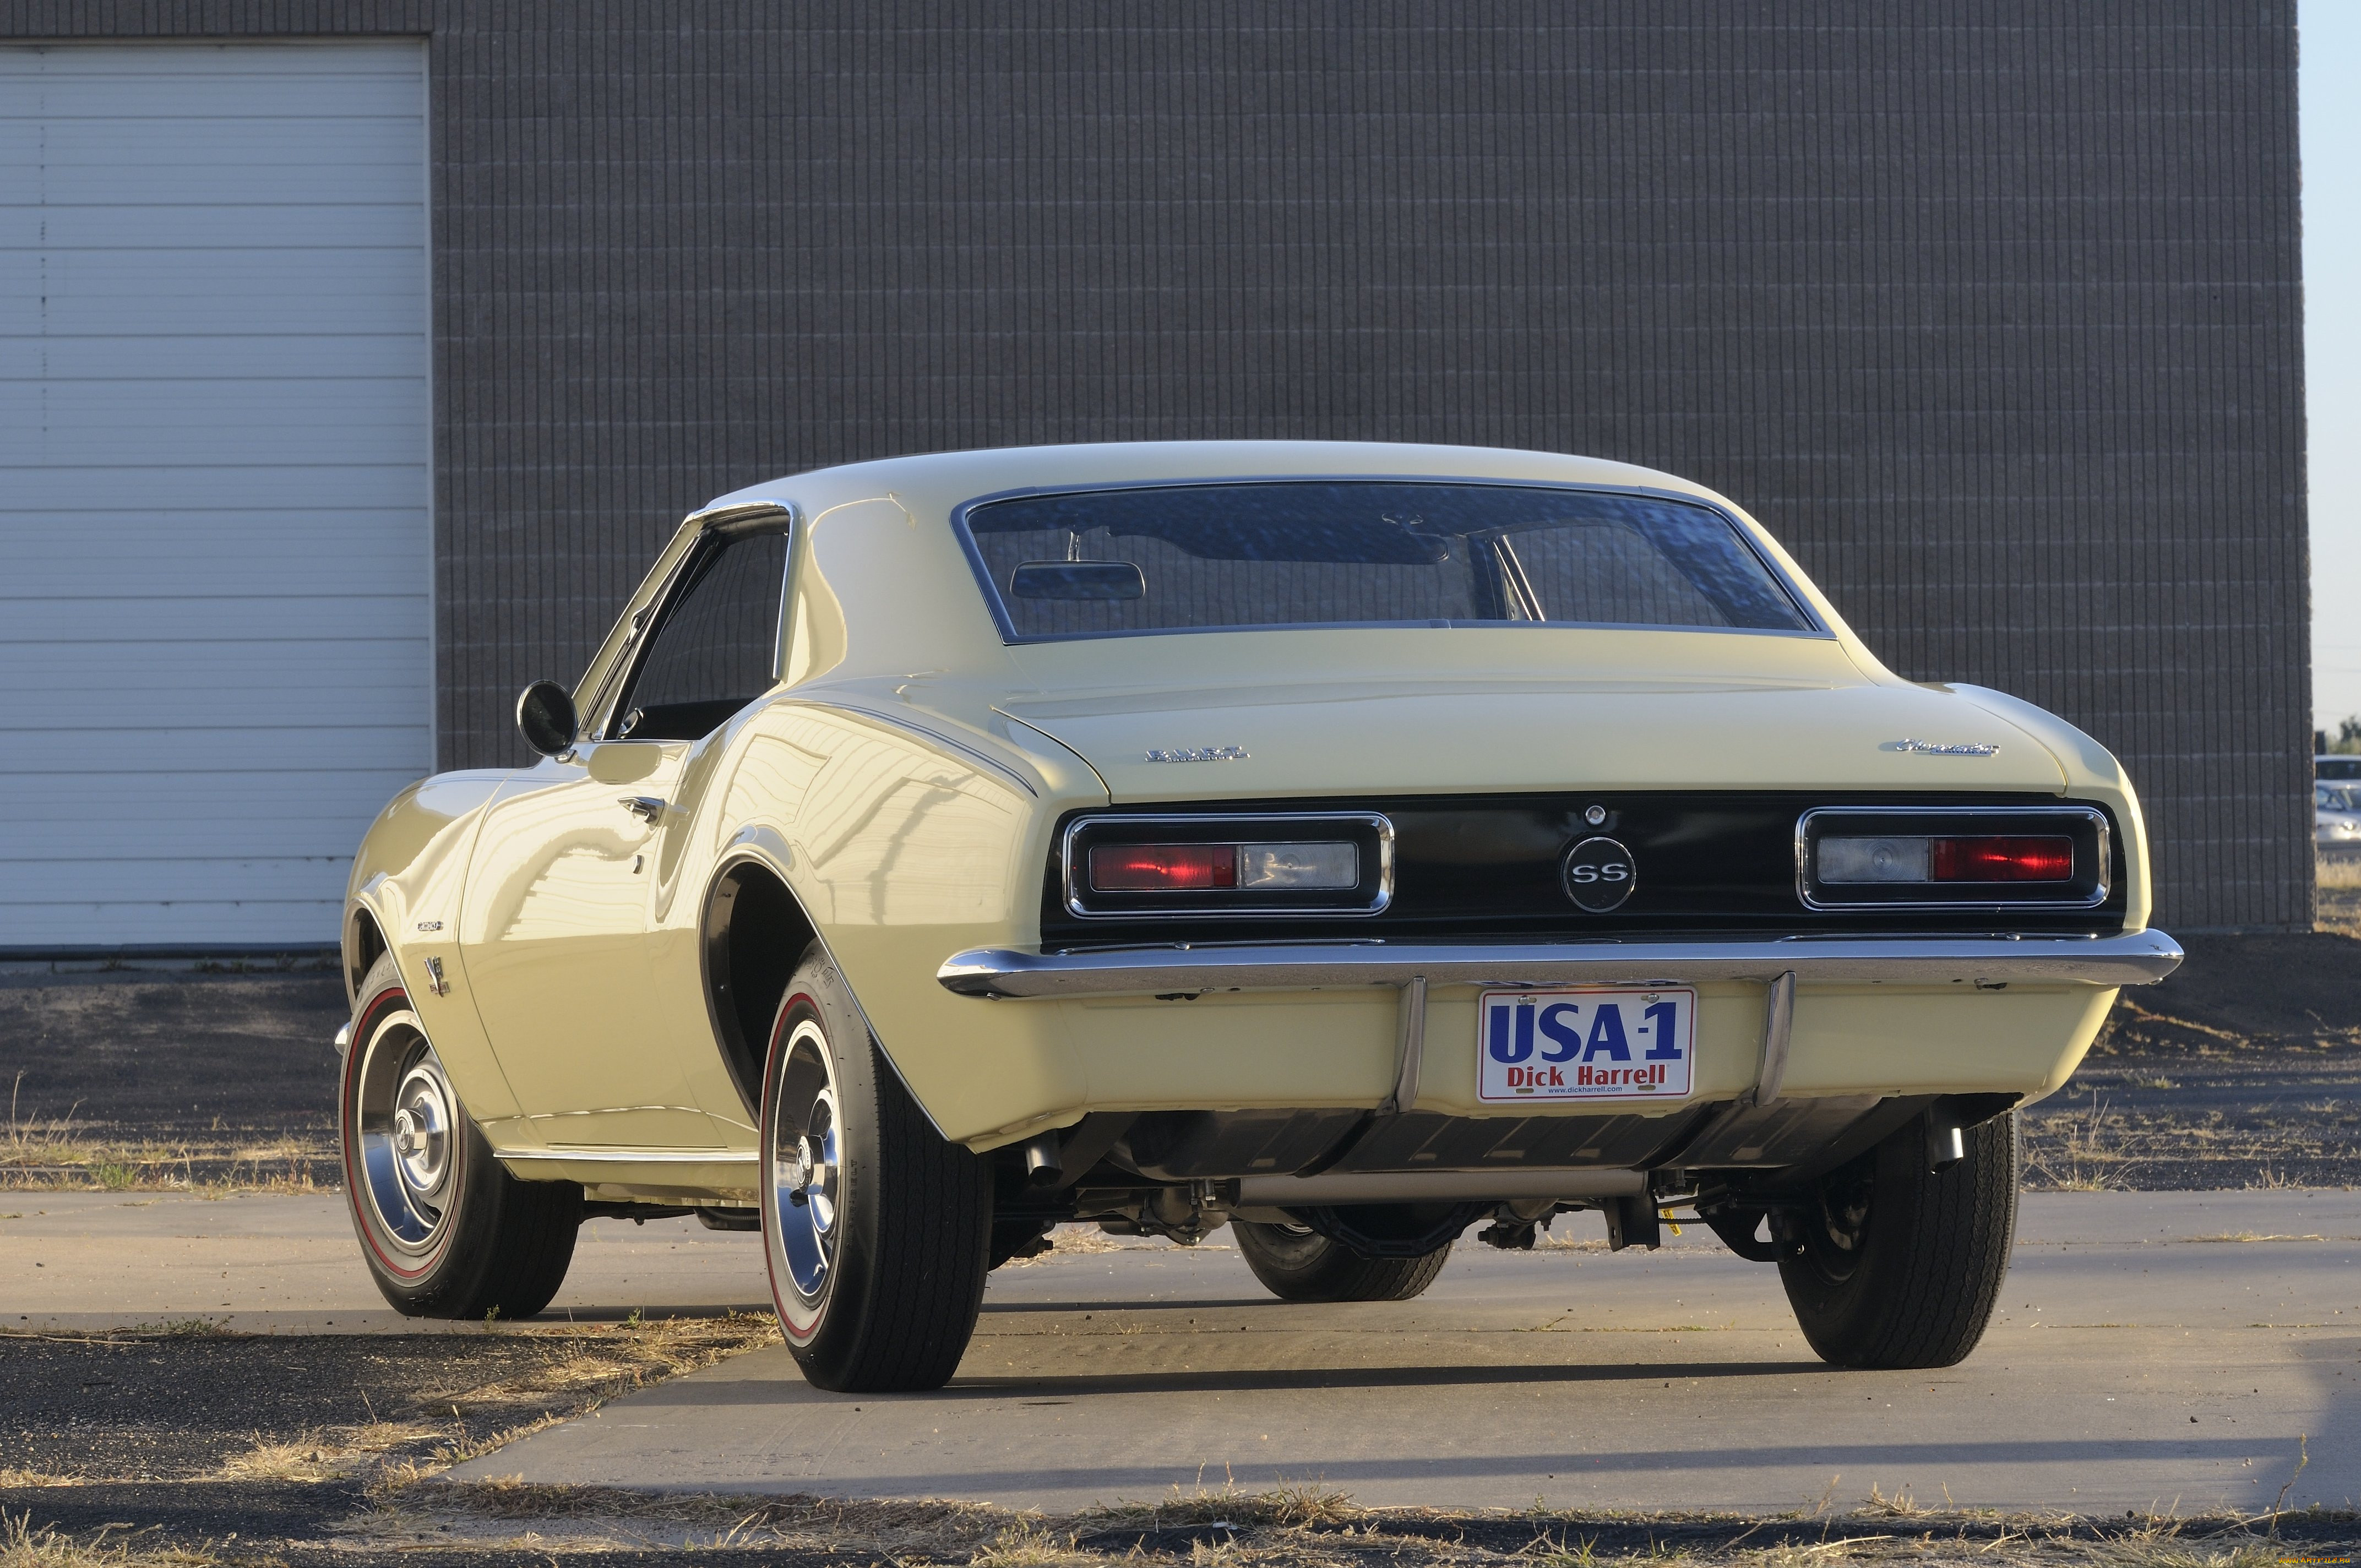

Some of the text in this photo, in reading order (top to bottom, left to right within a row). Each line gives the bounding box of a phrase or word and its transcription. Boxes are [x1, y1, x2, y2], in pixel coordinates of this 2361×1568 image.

[1573, 863, 1628, 883] SS
[1489, 1002, 1683, 1064] USA-1
[1507, 1064, 1666, 1087] Dick Harrell
